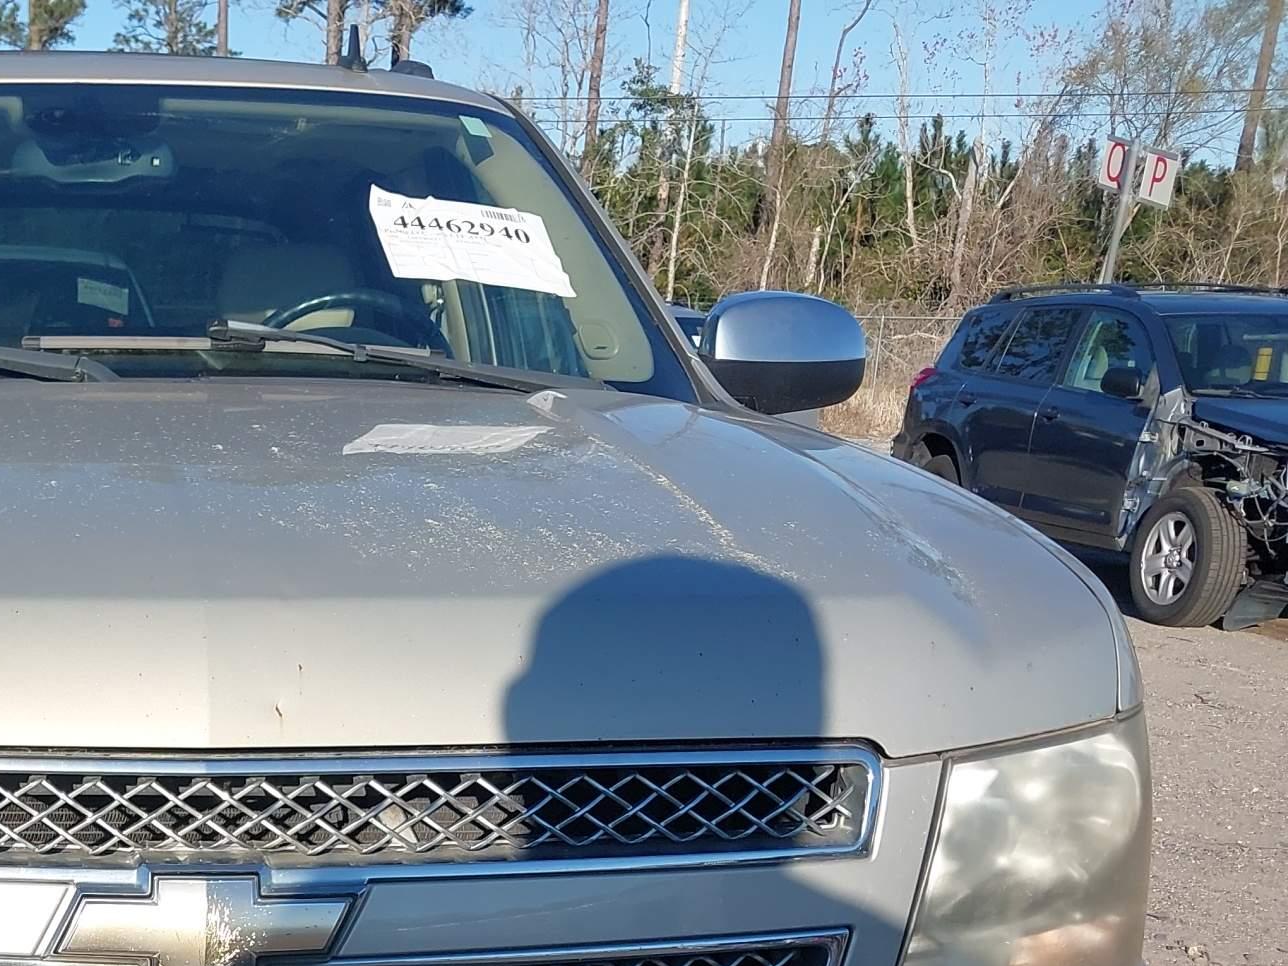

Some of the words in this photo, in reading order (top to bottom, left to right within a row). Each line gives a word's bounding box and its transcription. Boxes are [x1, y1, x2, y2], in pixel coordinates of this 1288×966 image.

[1107, 142, 1126, 190] Q
[1148, 156, 1168, 197] P
[393, 215, 531, 245] 44462940
